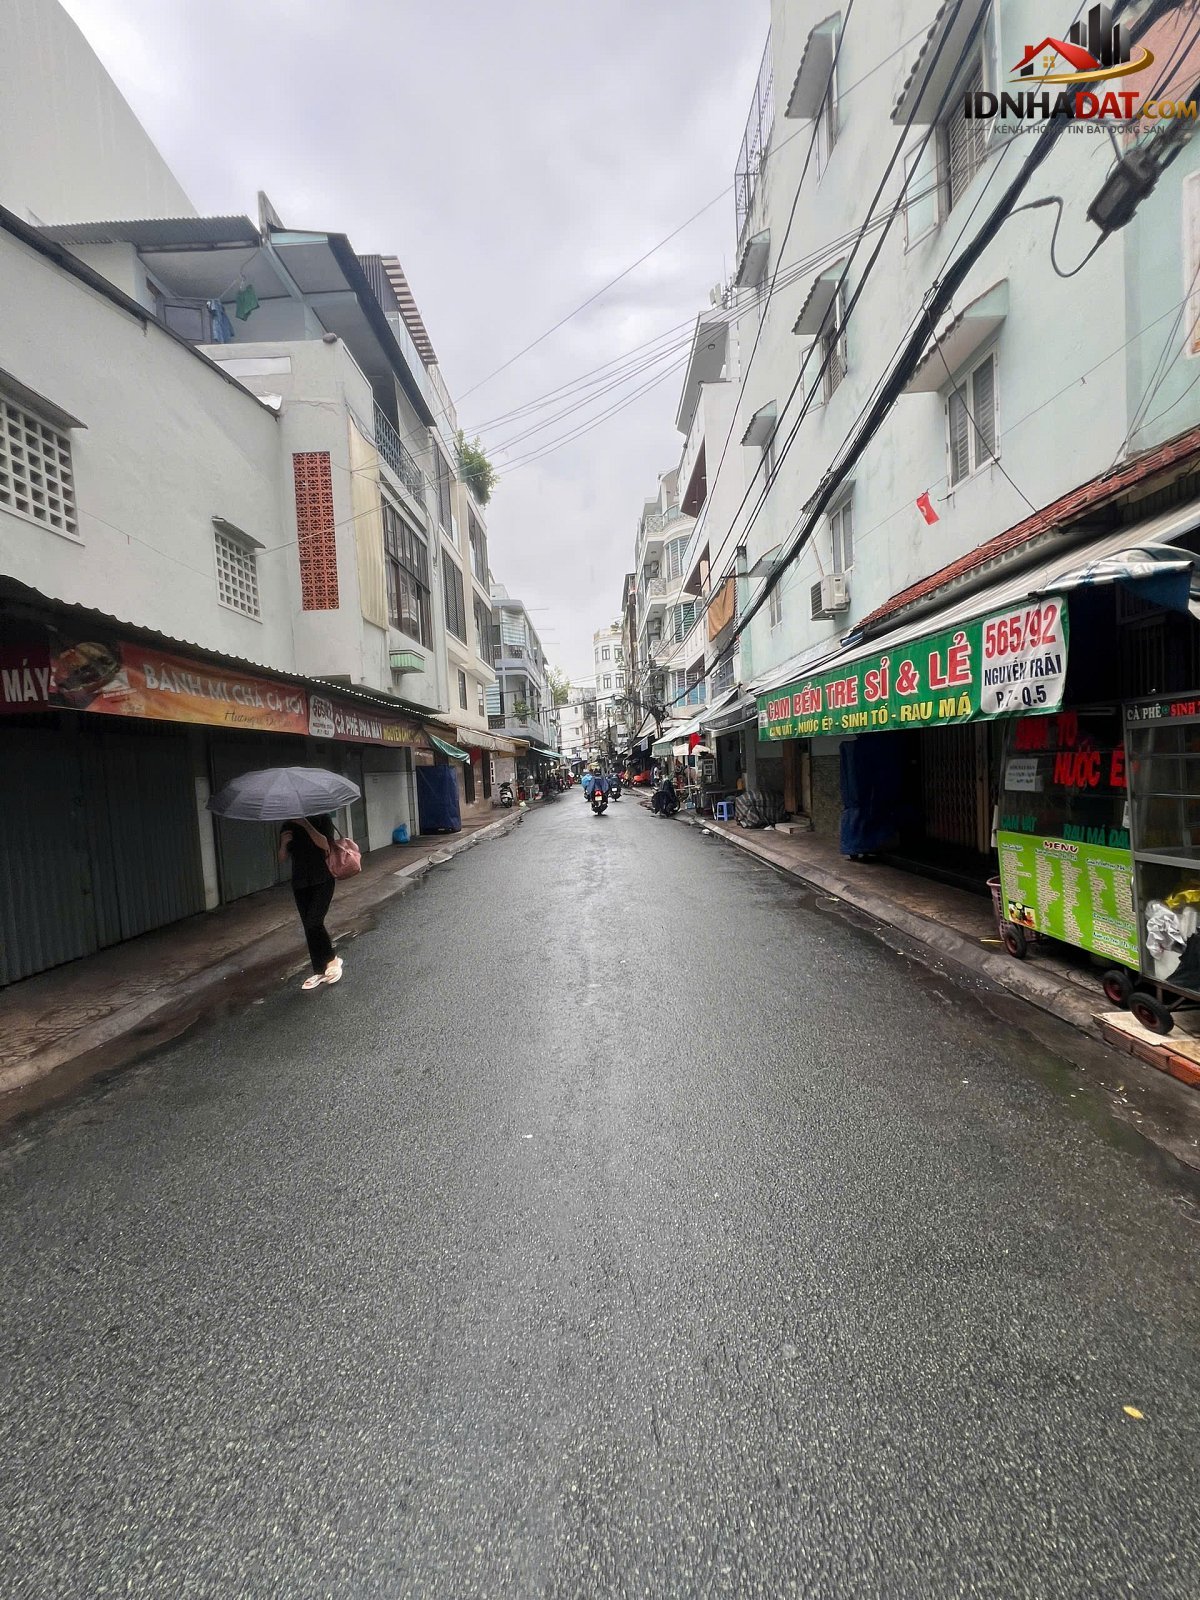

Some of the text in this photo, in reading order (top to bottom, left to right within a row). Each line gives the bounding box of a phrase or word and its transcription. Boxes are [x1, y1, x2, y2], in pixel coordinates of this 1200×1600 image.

[985, 604, 1058, 659] 565/92
[1, 657, 50, 702] MÁY
[143, 662, 205, 698] BÁNH
[767, 695, 791, 722] CAM
[793, 681, 822, 717] BẾN
[825, 675, 858, 710] TRE
[864, 655, 890, 702] SỈ
[895, 659, 920, 696] &
[929, 631, 973, 690] LẺ
[1029, 652, 1062, 679] TRÃI
[822, 715, 833, 731] ÉP
[842, 711, 868, 729] SINH
[871, 702, 888, 725] TỐ
[900, 701, 932, 721] RAU
[939, 691, 971, 718] MÁ
[1022, 685, 1047, 707] Q.5
[1127, 704, 1140, 720] CÀ
[1170, 701, 1196, 717] SINH
[1053, 740, 1101, 788] NƯỚC
[1043, 840, 1079, 854] MENU
[1086, 823, 1106, 847] MÁ
